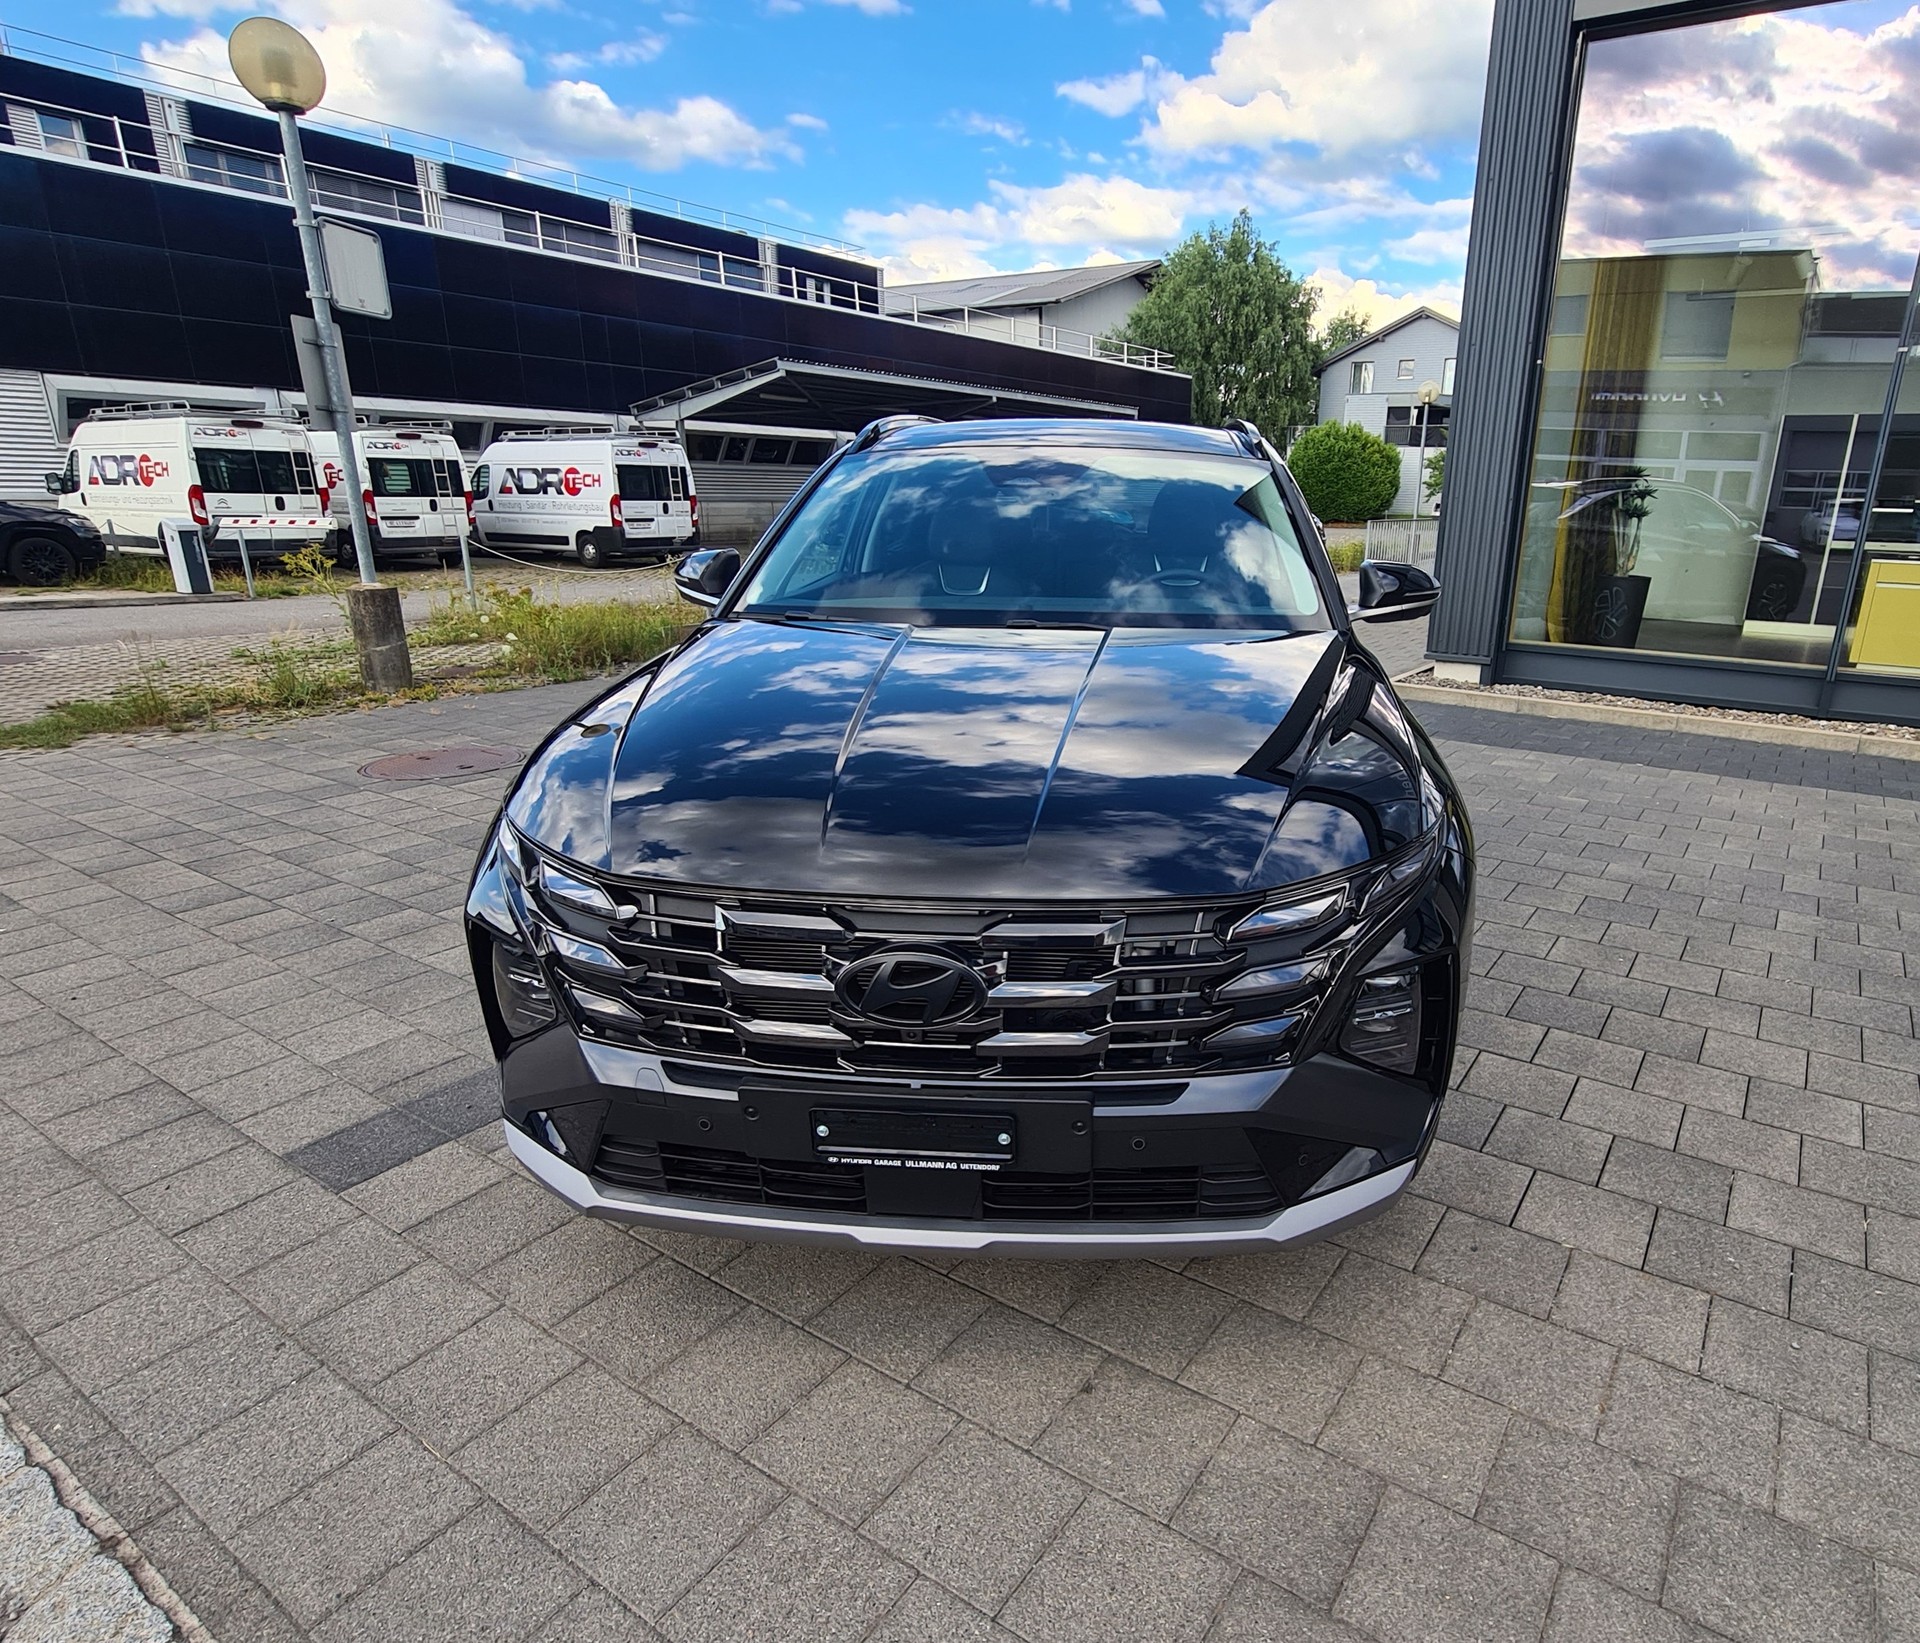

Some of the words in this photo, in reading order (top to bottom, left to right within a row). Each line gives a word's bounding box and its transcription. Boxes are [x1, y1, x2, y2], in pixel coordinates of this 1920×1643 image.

[874, 1159, 902, 1167] GARAGE
[905, 1160, 945, 1169] ULLMANN
[945, 1162, 958, 1170] AG
[960, 1163, 1000, 1171] UETENDORF
